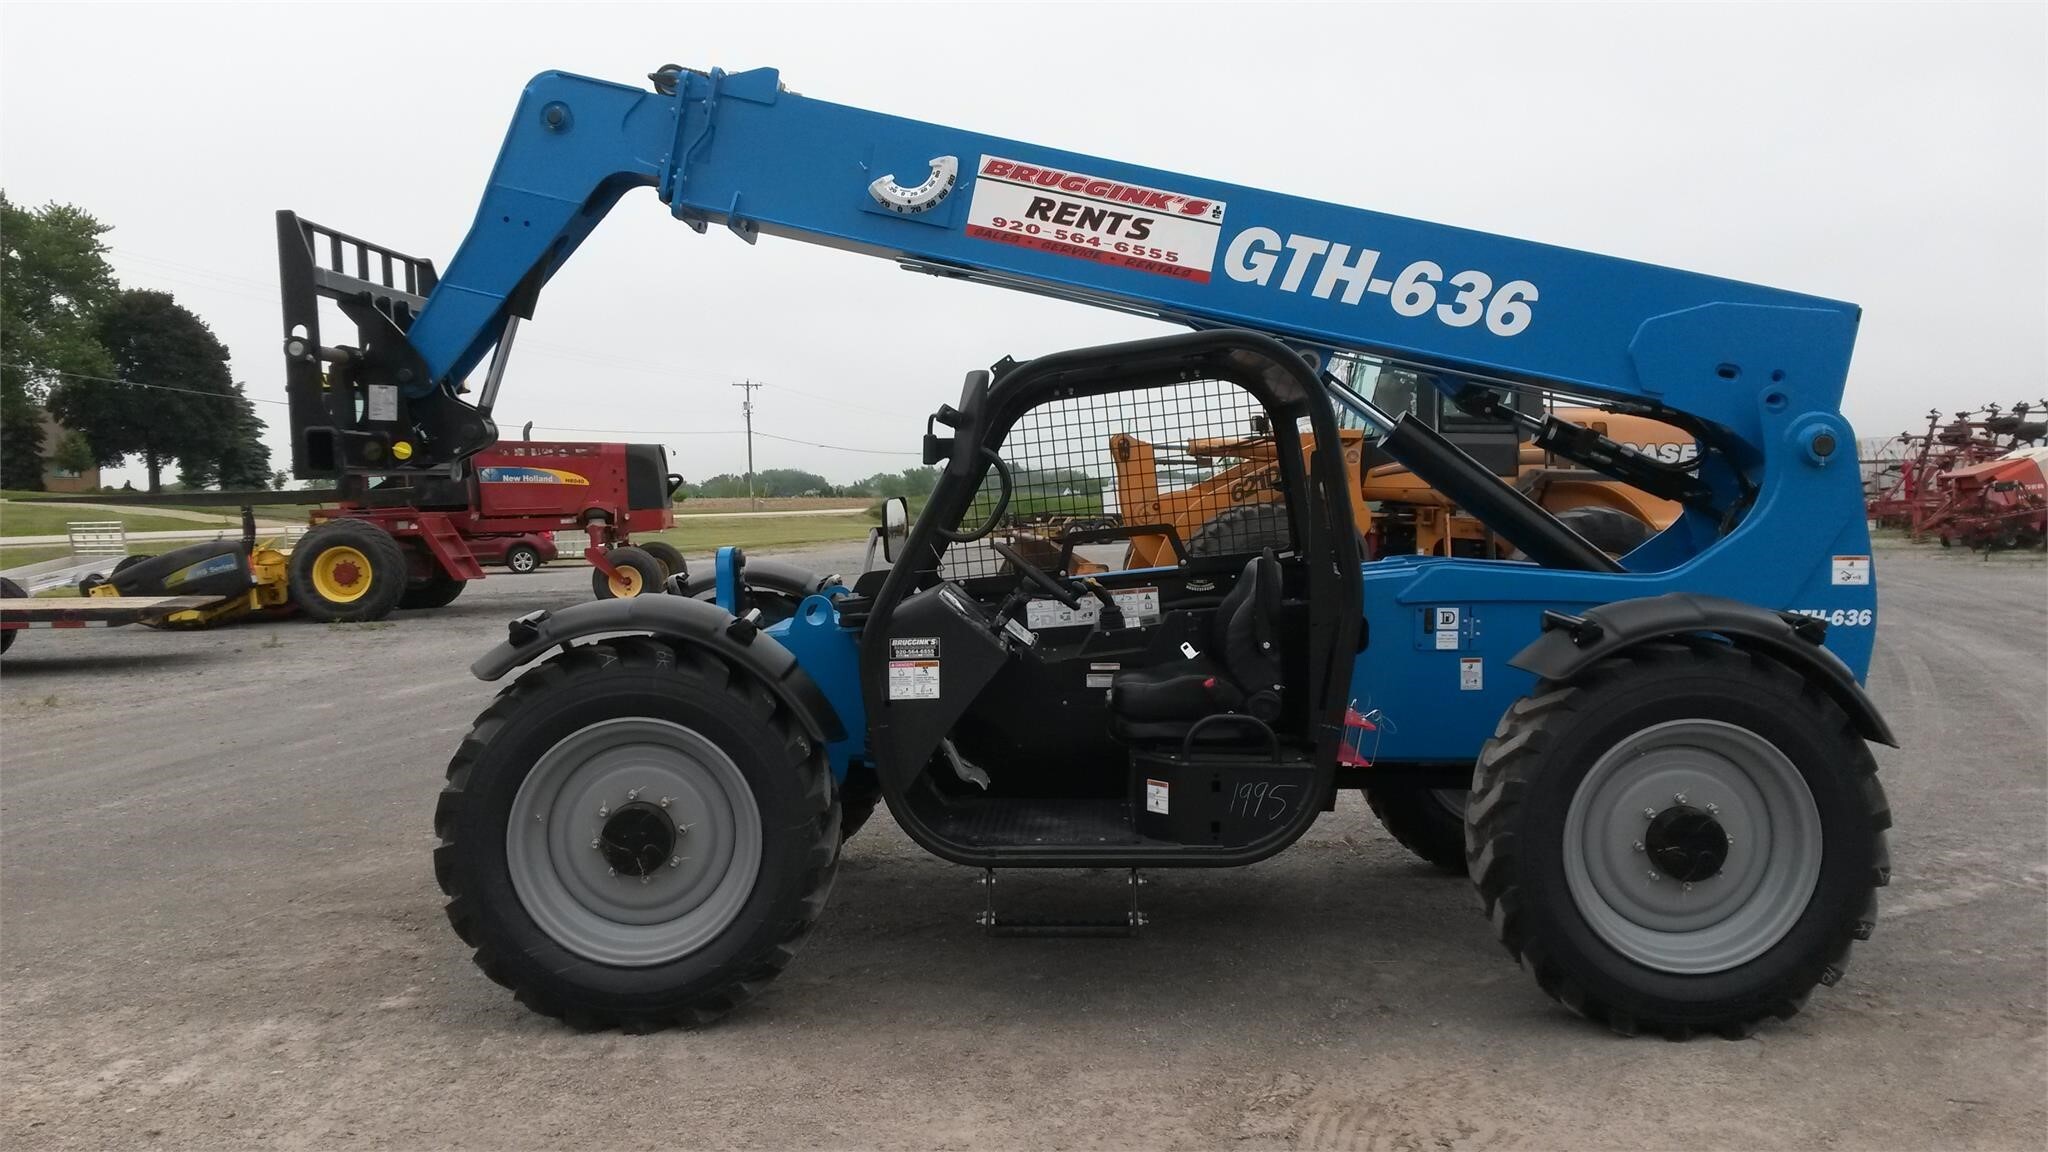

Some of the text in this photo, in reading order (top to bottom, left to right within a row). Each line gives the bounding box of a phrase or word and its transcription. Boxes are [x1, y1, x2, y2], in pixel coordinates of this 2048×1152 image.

[926, 199, 937, 209] 40
[980, 158, 1212, 217] BRUGGINK'S
[992, 216, 1179, 263] 920-564-6555
[1025, 196, 1155, 241] RENTS
[1224, 226, 1539, 338] GTH-636
[502, 474, 553, 483] New Holland
[1229, 782, 1298, 821] 1995
